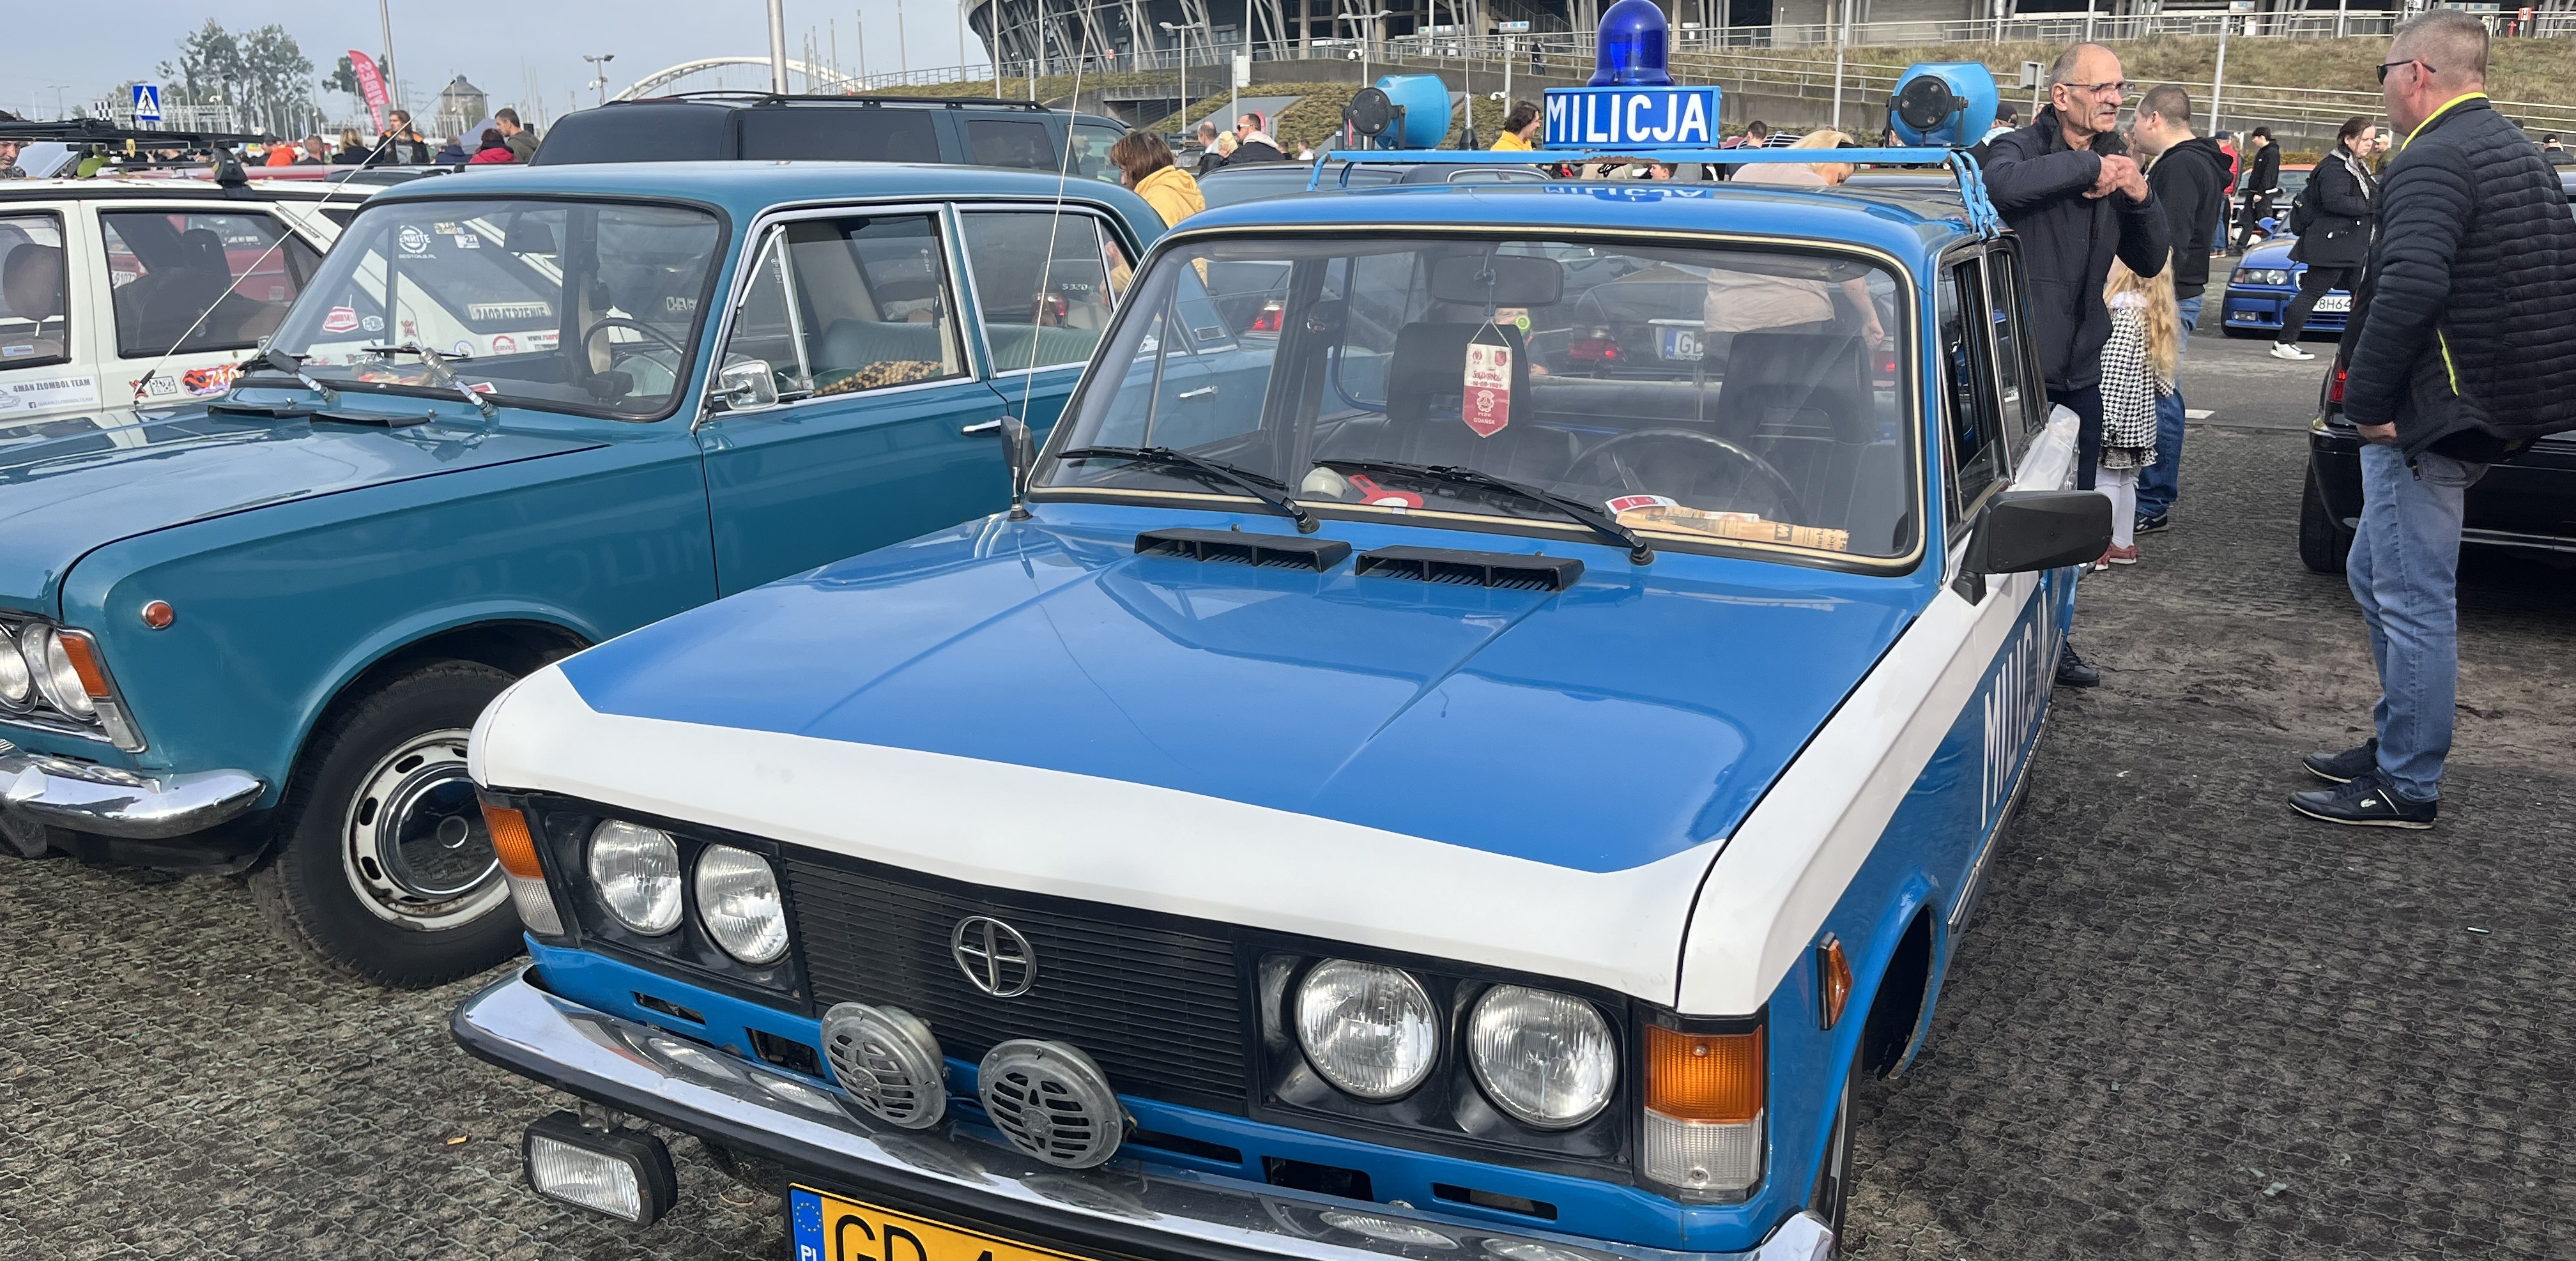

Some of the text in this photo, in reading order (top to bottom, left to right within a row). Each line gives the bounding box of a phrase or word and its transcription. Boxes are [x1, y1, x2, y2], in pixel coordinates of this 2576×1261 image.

[1545, 93, 1708, 142] MILICJA
[13, 384, 35, 392] 4MAN
[70, 379, 91, 387] TEAM
